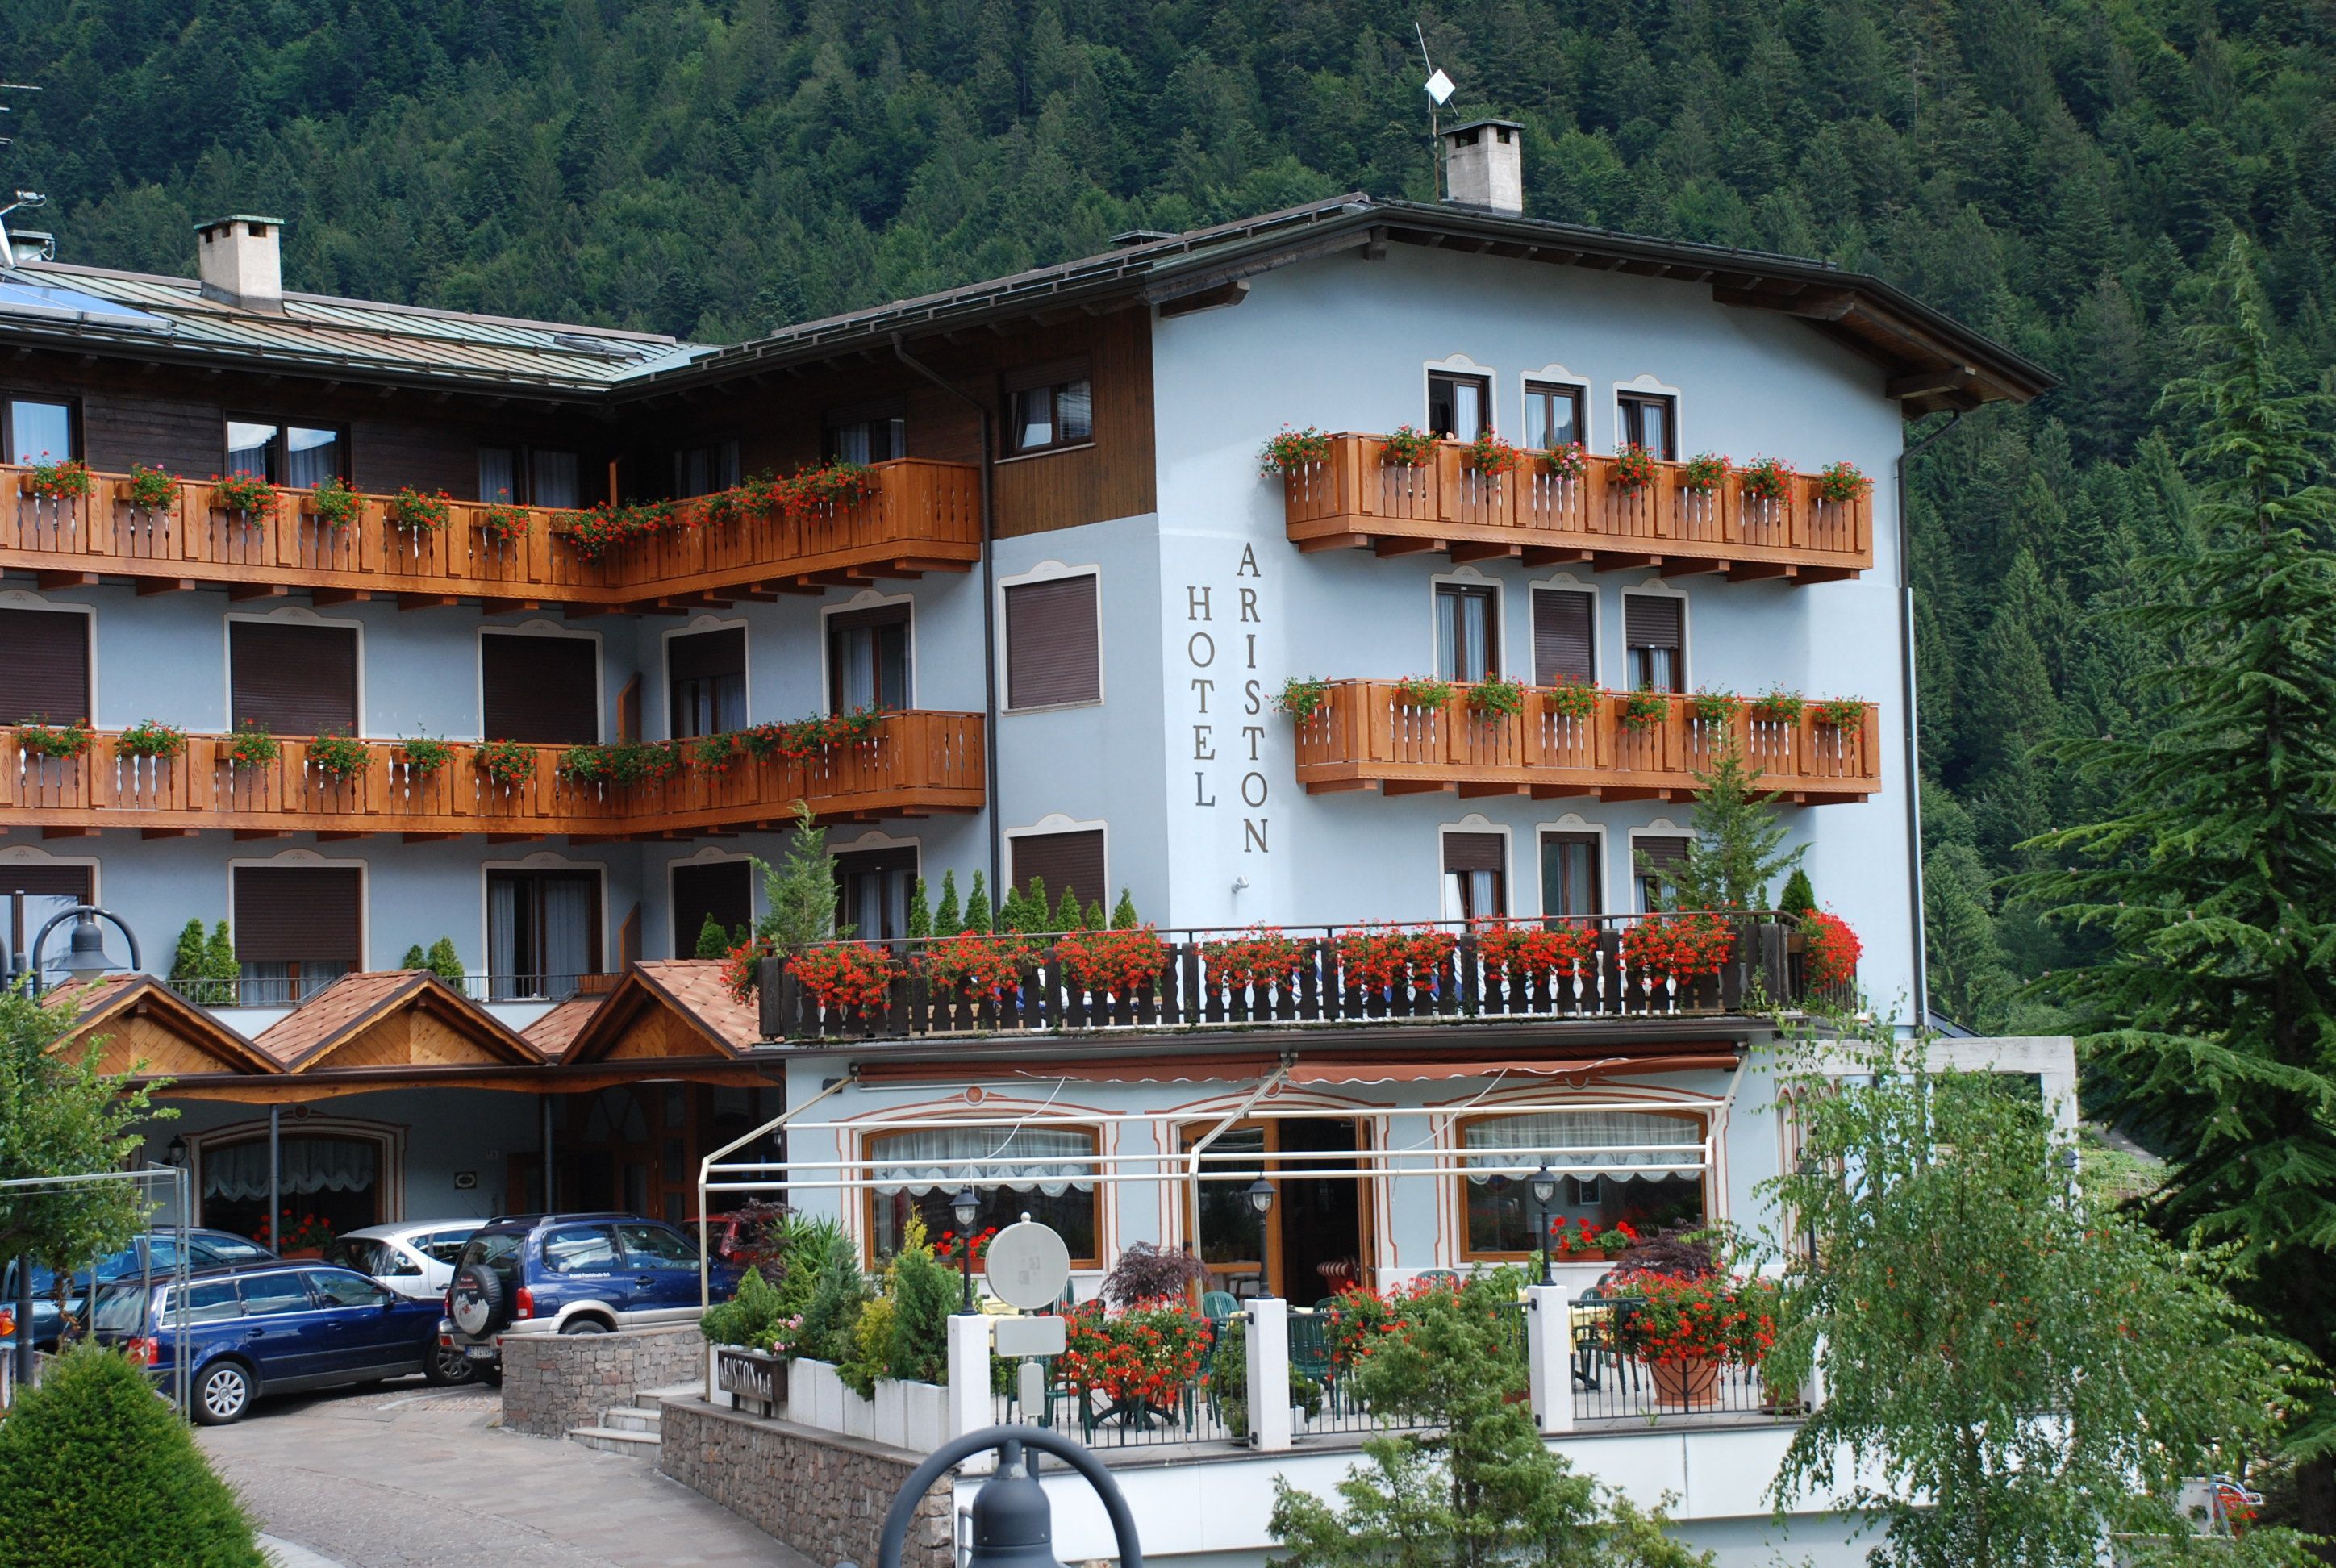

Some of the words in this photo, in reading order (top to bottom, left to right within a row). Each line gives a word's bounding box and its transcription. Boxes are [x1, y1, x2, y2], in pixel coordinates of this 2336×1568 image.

[1187, 586, 1216, 807] HOTEL
[1237, 542, 1268, 853] ARISTON
[720, 1356, 756, 1390] ARISTON
